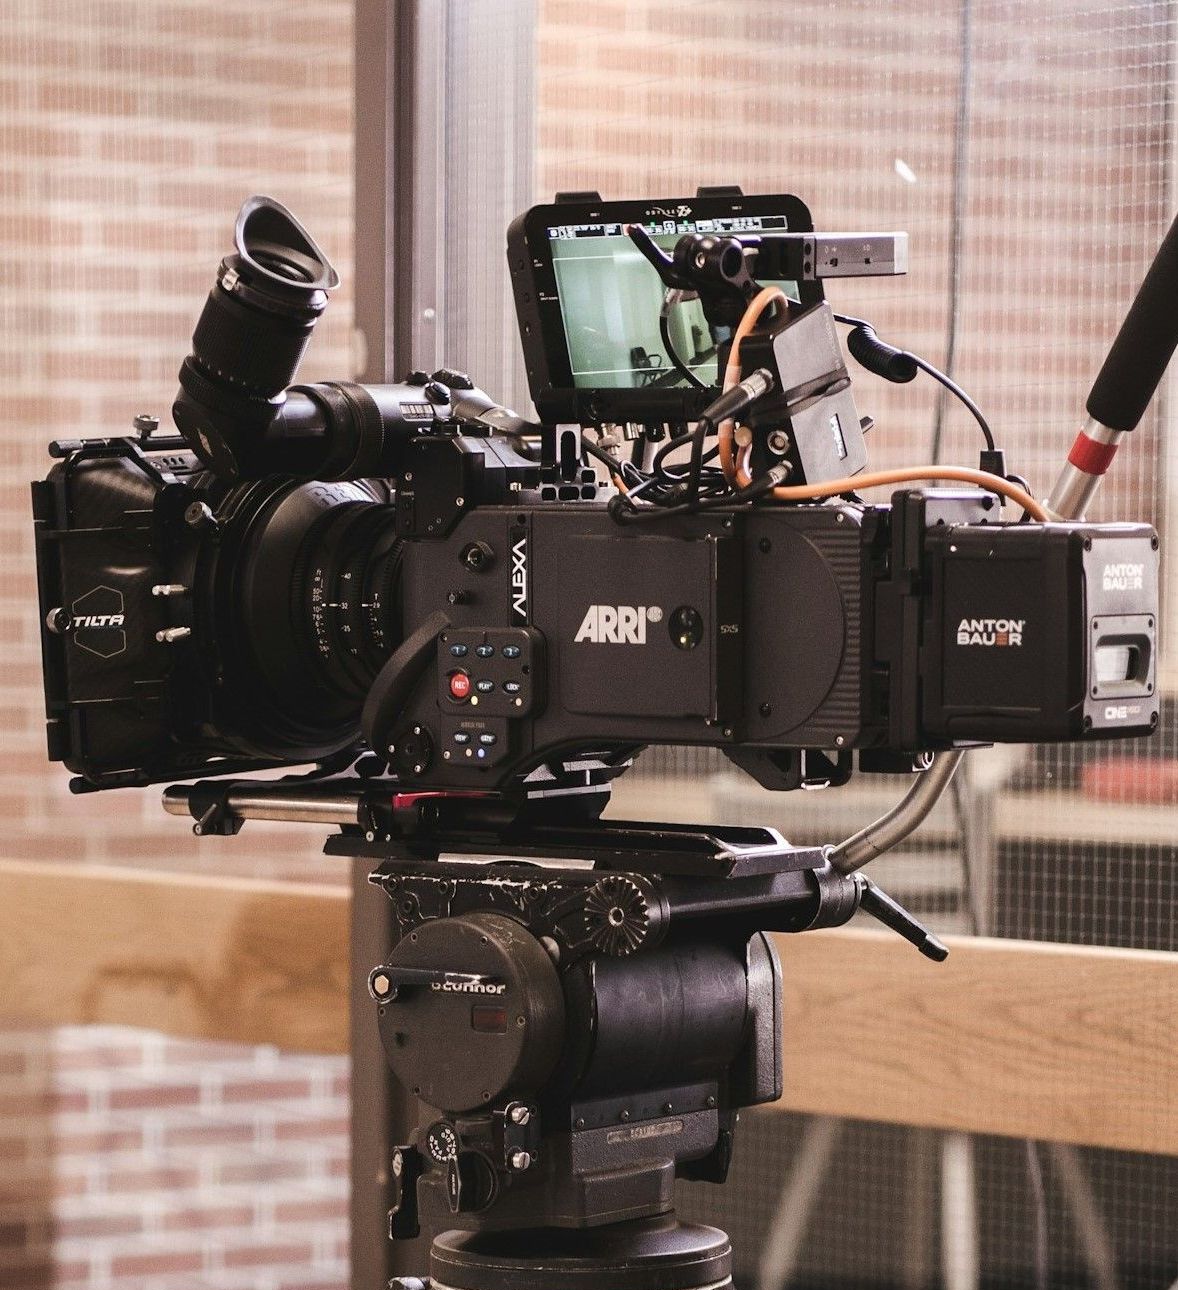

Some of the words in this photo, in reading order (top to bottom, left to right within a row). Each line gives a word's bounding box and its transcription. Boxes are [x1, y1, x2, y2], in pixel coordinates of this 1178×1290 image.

[512, 538, 526, 617] ALEXA
[1104, 565, 1142, 577] ANTON
[1103, 577, 1142, 591] BAUER
[73, 614, 125, 627] TILTA
[574, 605, 646, 644] ARRI
[957, 619, 1023, 632] ANTON
[957, 632, 1022, 646] BAUER
[454, 681, 466, 690] REC
[478, 682, 491, 690] PLAY
